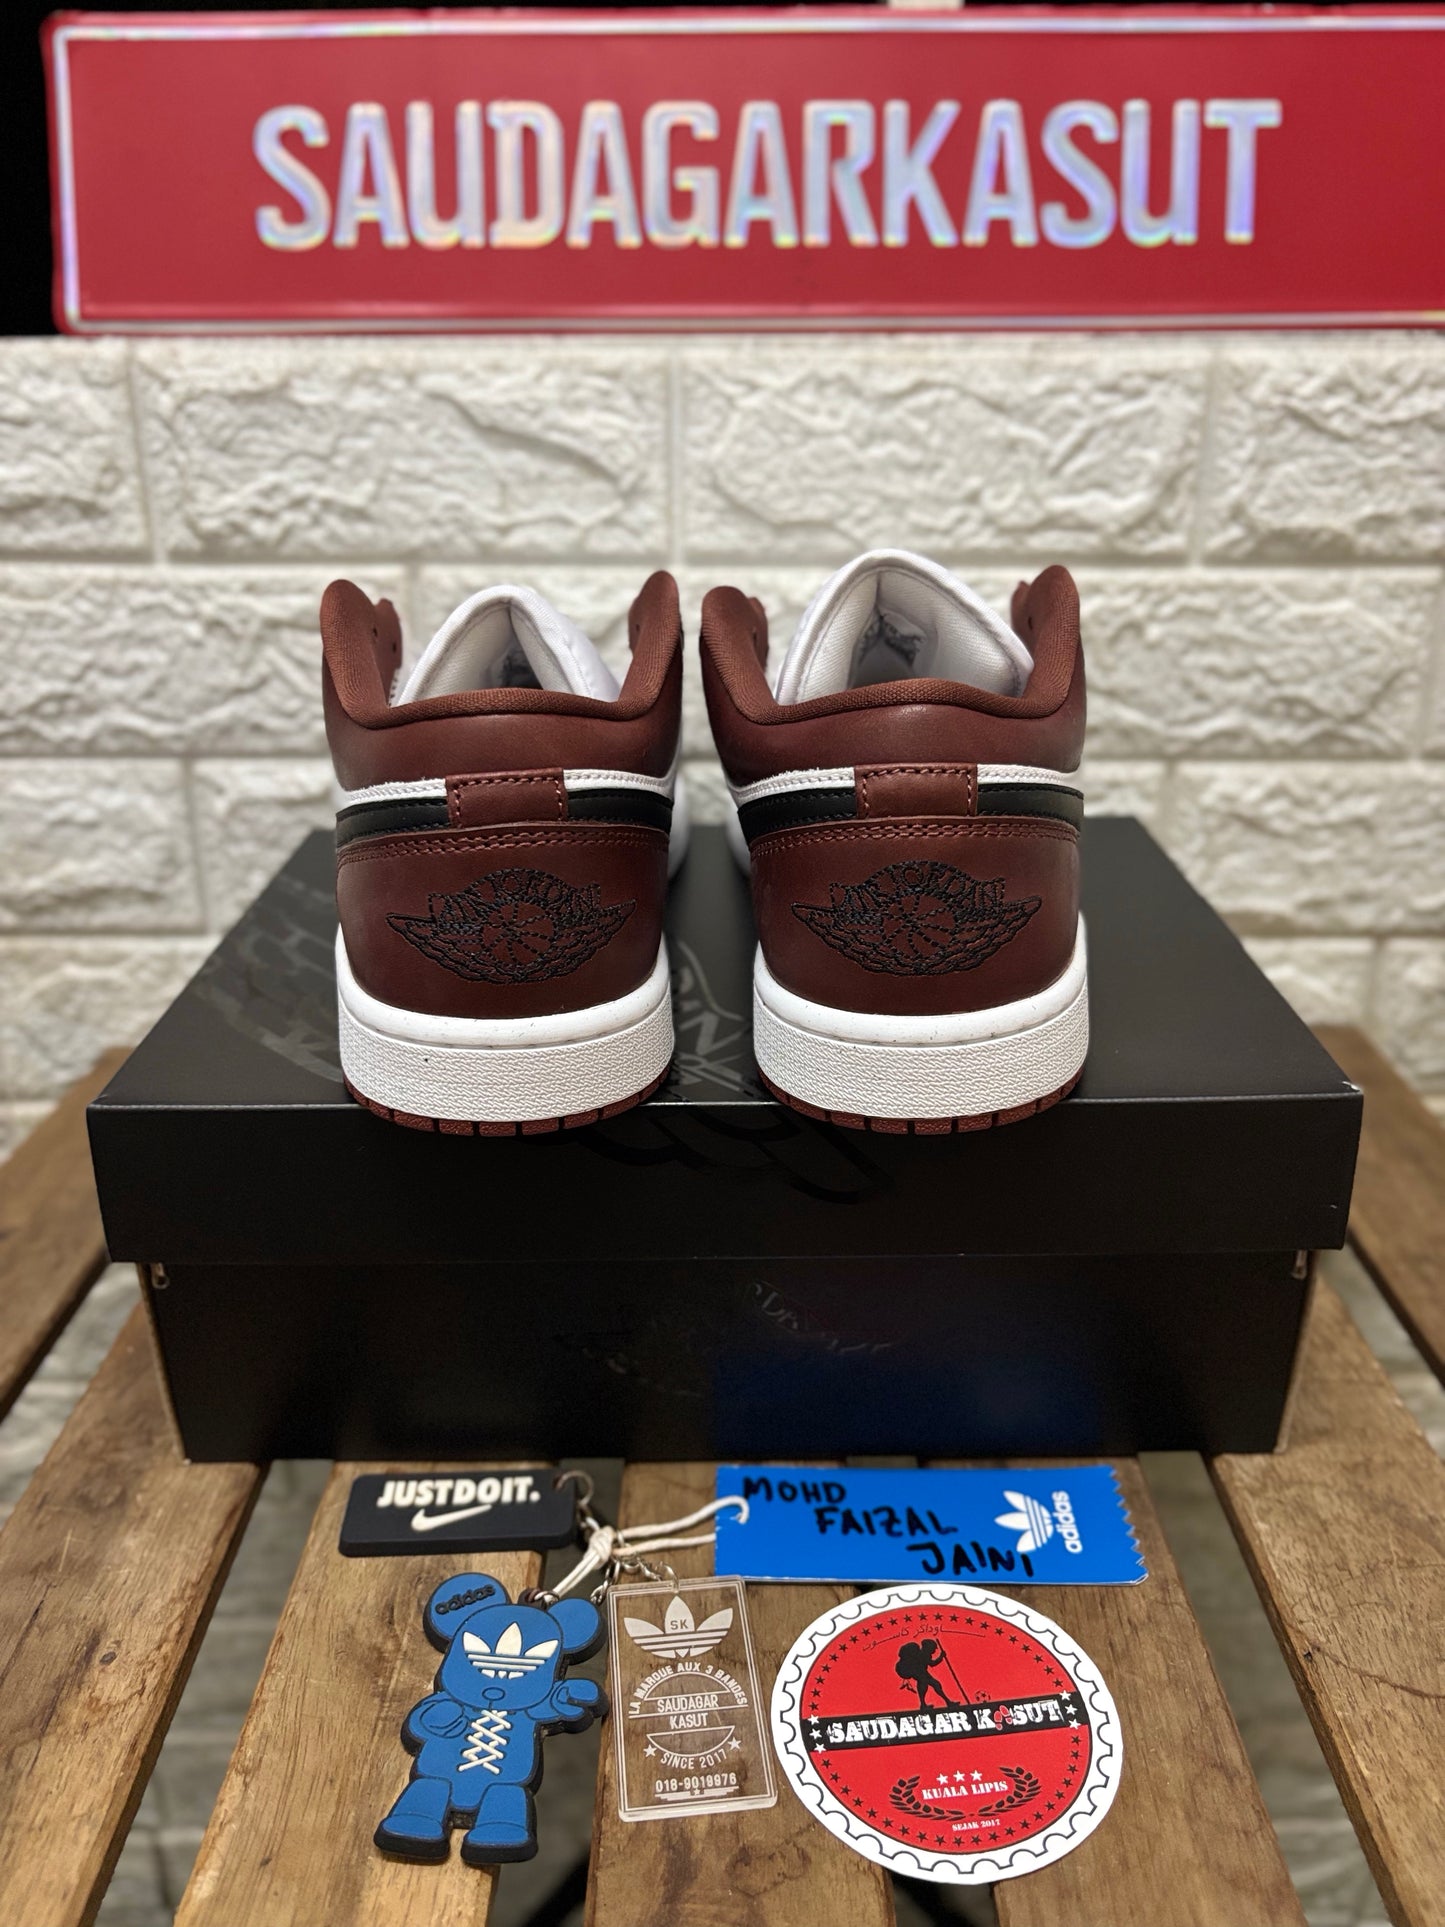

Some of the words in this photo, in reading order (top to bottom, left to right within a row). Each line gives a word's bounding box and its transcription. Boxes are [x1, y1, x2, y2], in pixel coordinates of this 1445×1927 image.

[251, 99, 1283, 250] SAUDAGARKASUT
[742, 1476, 847, 1503] MOHD
[814, 1506, 959, 1537] FAIZAL
[1052, 1490, 1083, 1554] adidas
[906, 1541, 1034, 1578] JAINI
[435, 1584, 496, 1615] adidas
[670, 1619, 689, 1631] SK
[628, 1700, 642, 1715] LA
[677, 1661, 701, 1673] AUX
[705, 1666, 713, 1674] 3
[714, 1669, 748, 1705] BANDES
[657, 1694, 719, 1713] SAUDAGAR
[669, 1713, 709, 1730] KASUT
[826, 1710, 972, 1744] SAUDAGAR
[660, 1751, 695, 1770] SINCE
[699, 1749, 727, 1769] 2017
[921, 1785, 968, 1800] KUALA
[972, 1781, 1008, 1795] LIPIS
[952, 1822, 979, 1832] SEJAK
[980, 1818, 1001, 1829] 2017
